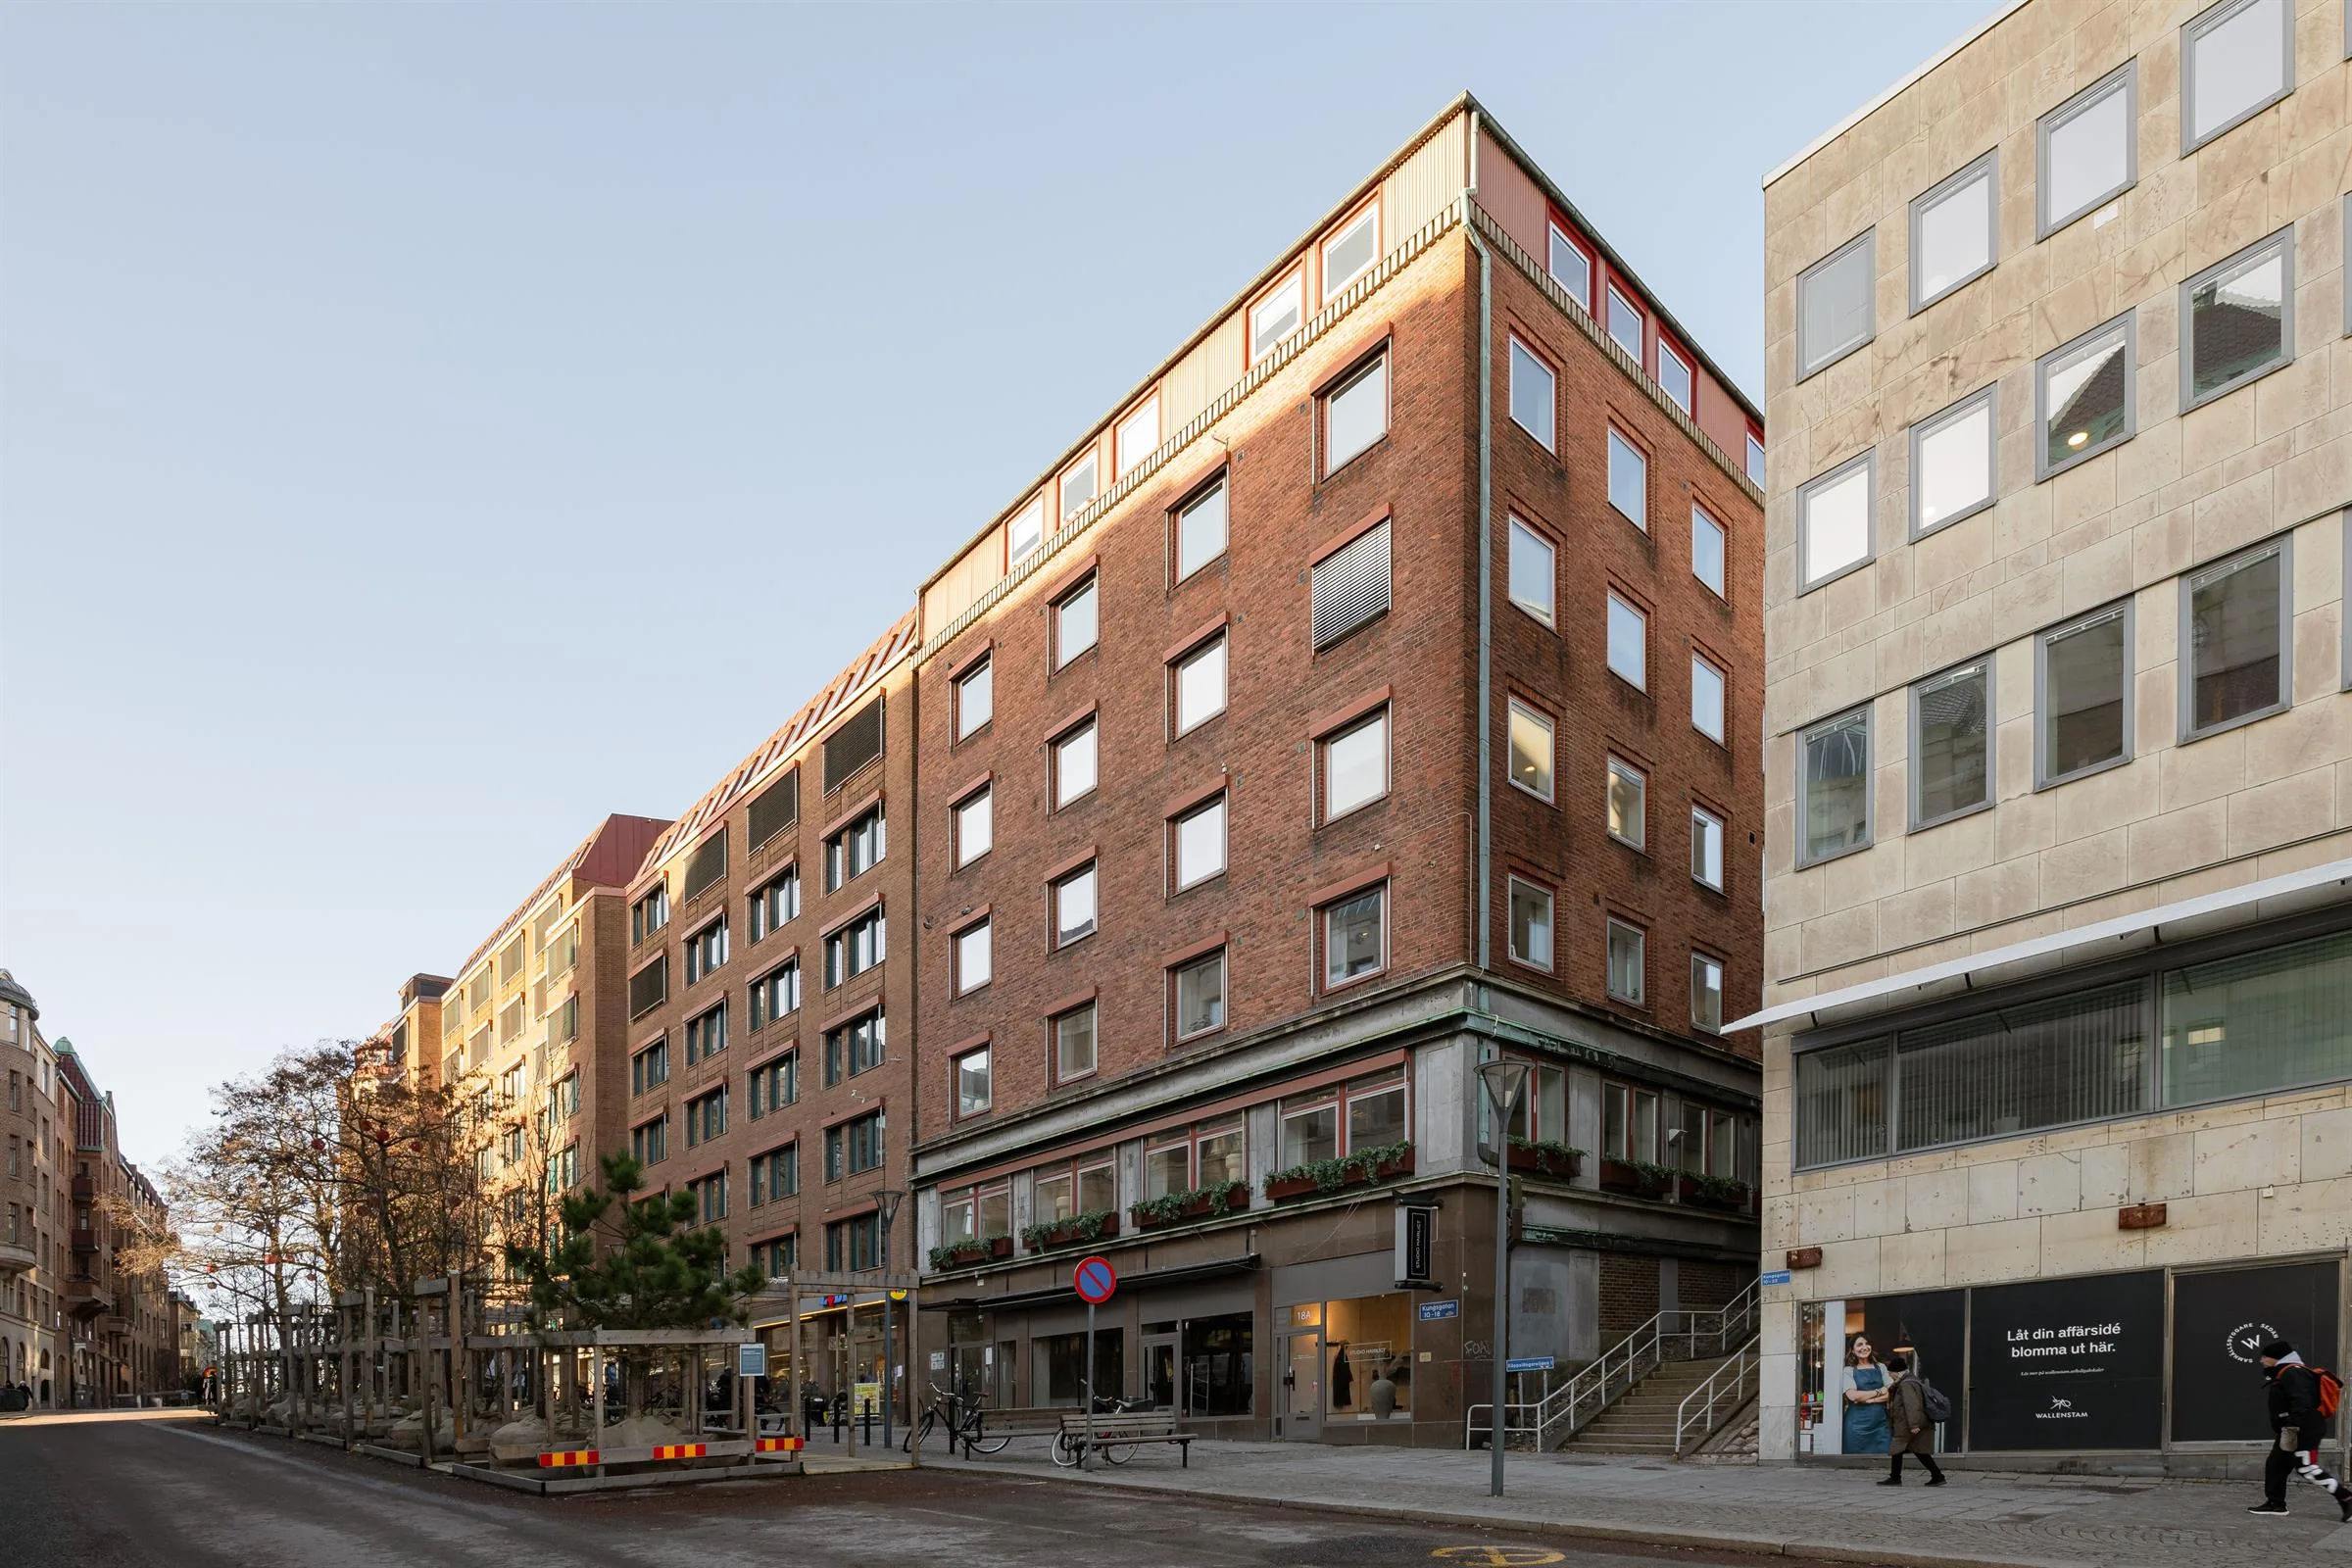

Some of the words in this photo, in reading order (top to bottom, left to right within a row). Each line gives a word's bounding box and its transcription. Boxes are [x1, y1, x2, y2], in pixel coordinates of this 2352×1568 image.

[1422, 1303, 1455, 1312] Kungsgatan
[1298, 1310, 1311, 1321] 18A
[2007, 1328, 2030, 1342] Låt
[2033, 1328, 2054, 1340] din
[2058, 1323, 2122, 1338] affärsidé
[2240, 1334, 2260, 1349] W
[2011, 1346, 2067, 1358] blomma
[2071, 1343, 2085, 1354] ut
[2089, 1342, 2116, 1353] här.
